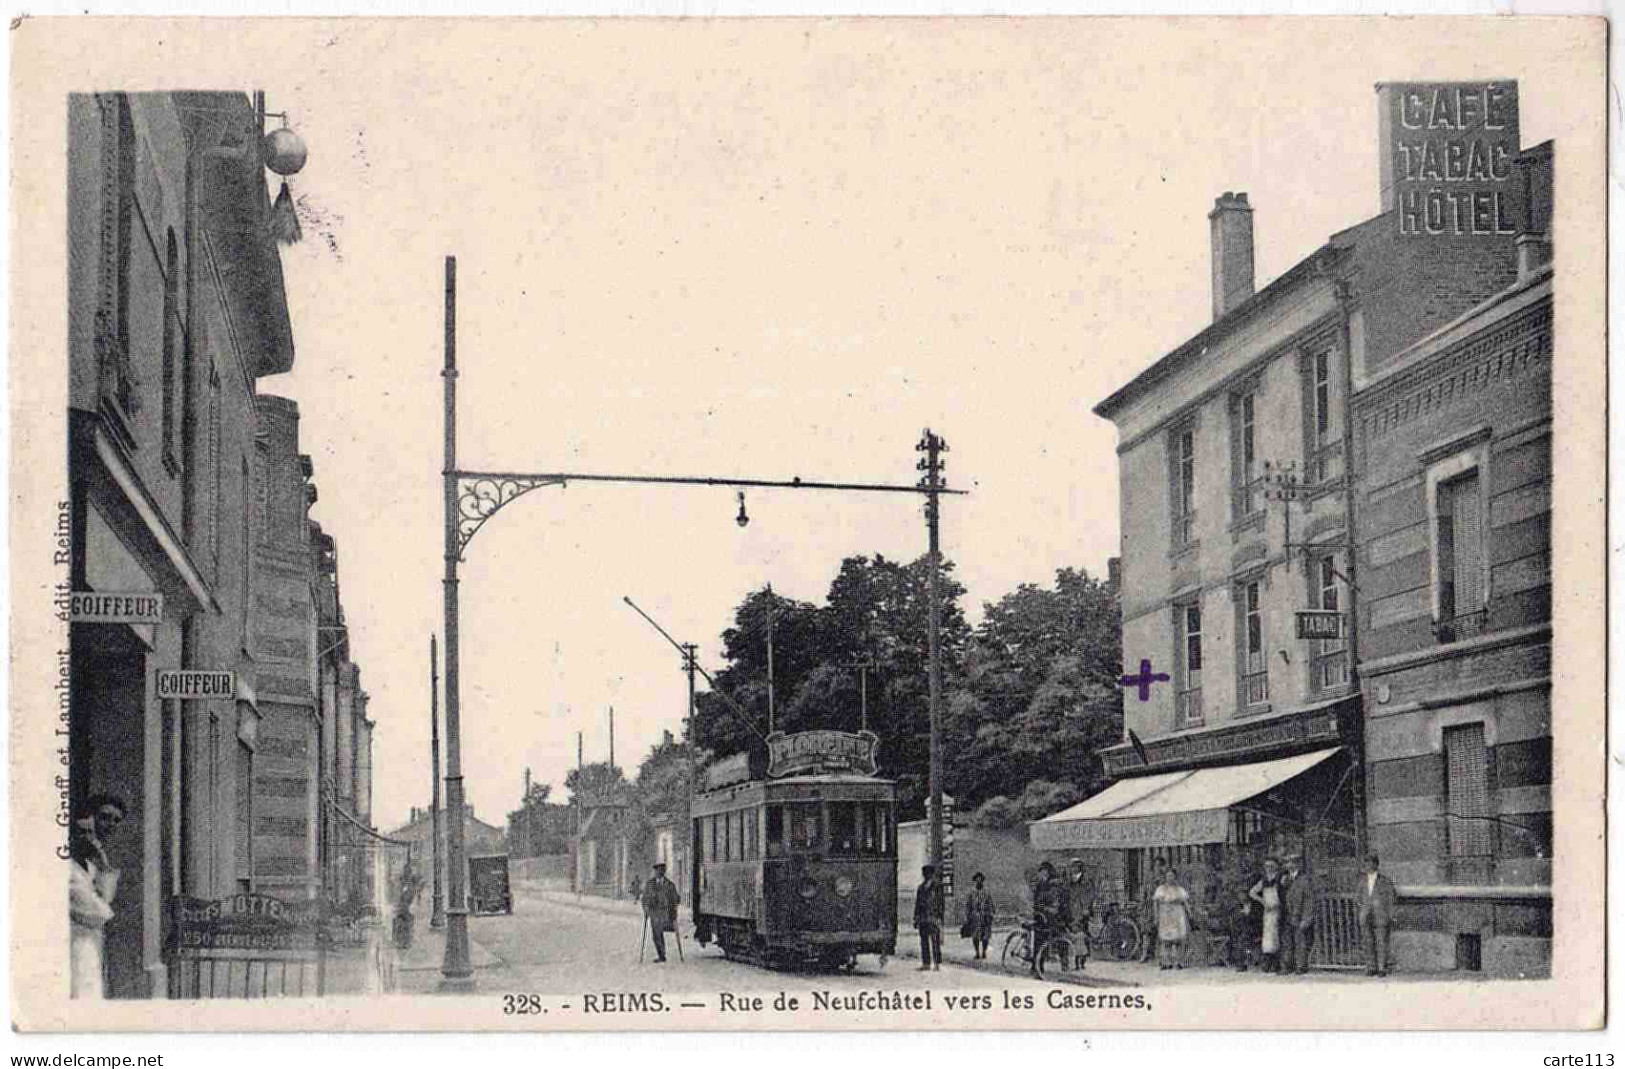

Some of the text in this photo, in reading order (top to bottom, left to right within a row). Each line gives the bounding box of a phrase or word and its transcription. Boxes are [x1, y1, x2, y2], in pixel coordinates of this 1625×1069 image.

[1400, 82, 1505, 130] CAFÉ
[1398, 141, 1509, 181] TABAC
[1399, 188, 1517, 235] HÔTEL
[54, 500, 71, 565] Reims
[71, 595, 161, 616] COIFFEUR
[55, 648, 71, 737] Lambert
[159, 672, 232, 695] COIFFEUR
[57, 748, 71, 766] et
[56, 774, 71, 827] Graff
[503, 994, 548, 1014] 328.
[584, 993, 671, 1013] REIMS.
[719, 992, 763, 1012] Rue
[773, 992, 799, 1012] de
[812, 990, 932, 1011] Neufchâtel
[944, 993, 993, 1010] vers
[1003, 990, 1035, 1010] les
